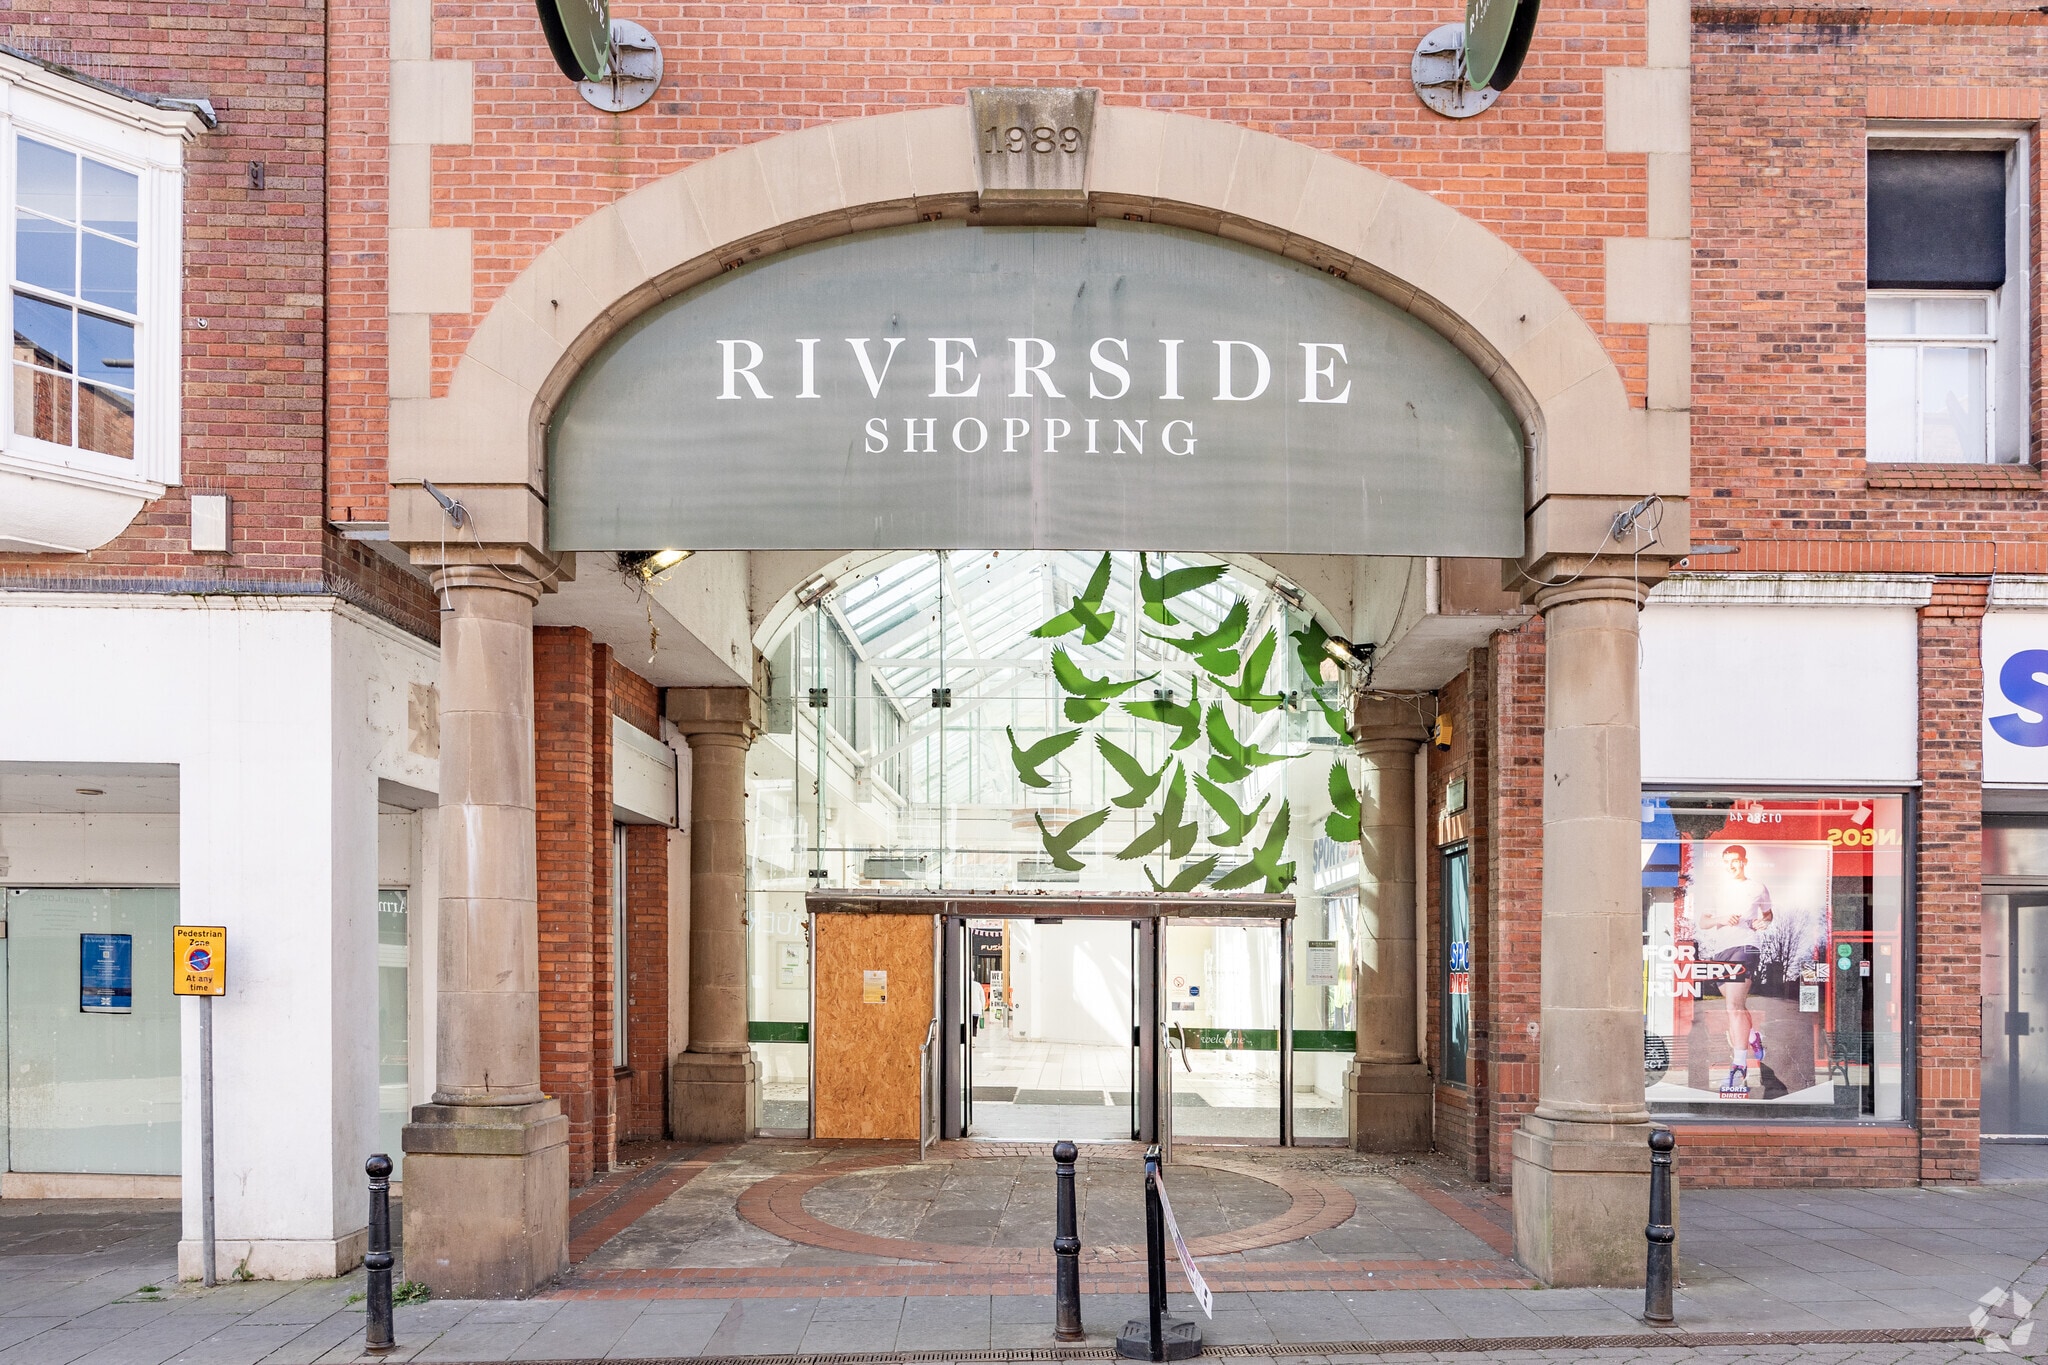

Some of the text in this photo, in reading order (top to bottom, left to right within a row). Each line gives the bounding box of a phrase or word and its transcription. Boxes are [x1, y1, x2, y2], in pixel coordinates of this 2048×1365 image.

[985, 126, 1081, 153] 1989
[716, 337, 1351, 404] RIVERSIDE
[865, 417, 1198, 456] SHOPPING
[177, 929, 222, 938] Pedestrian
[189, 938, 210, 947] Zone
[1642, 944, 1696, 961] FOR
[198, 976, 213, 984] any
[1655, 963, 1743, 980] EVERY
[190, 984, 209, 992] time
[1449, 973, 1469, 994] DIRE
[1648, 981, 1702, 998] RUN
[1721, 1085, 1747, 1093] SPORTS
